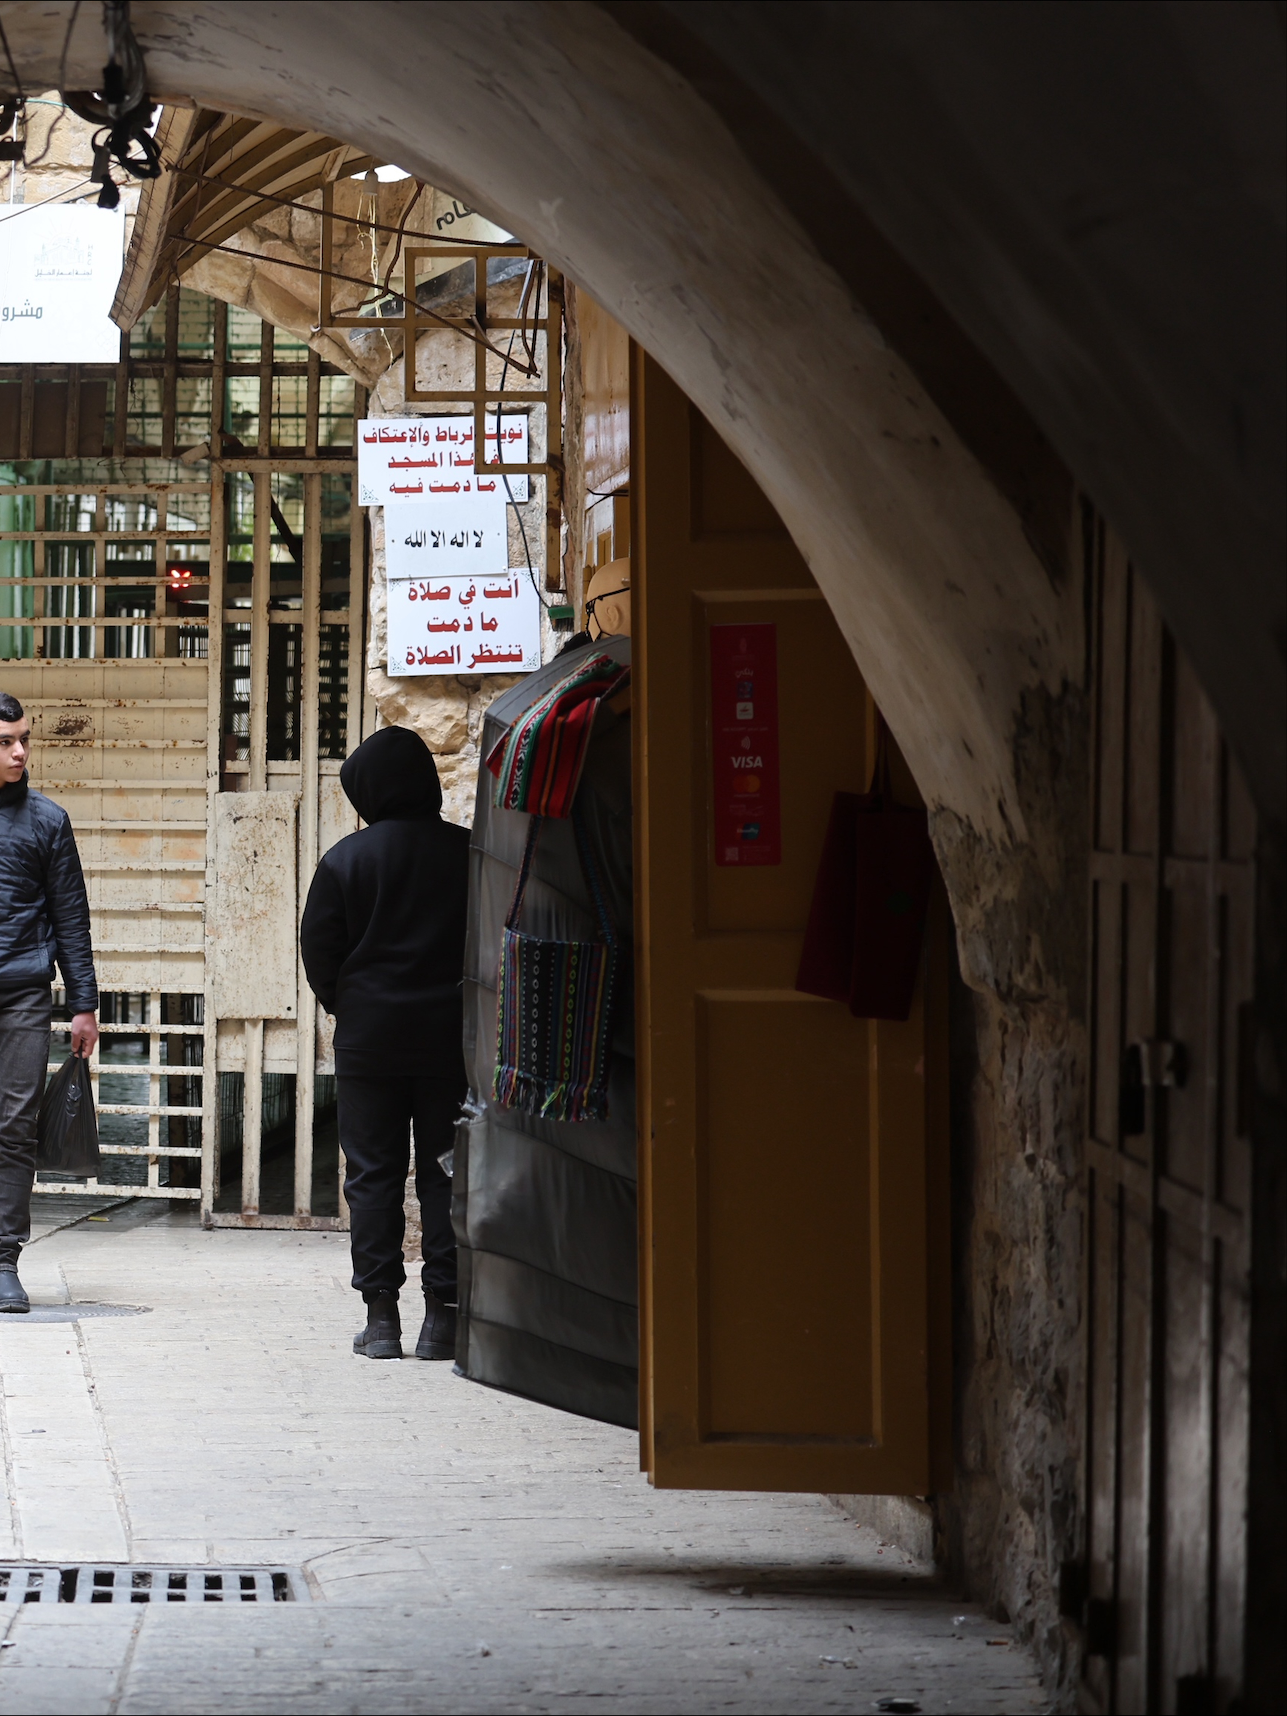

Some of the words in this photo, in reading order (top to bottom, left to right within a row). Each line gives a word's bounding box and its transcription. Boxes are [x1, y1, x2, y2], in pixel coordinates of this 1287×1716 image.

[435, 424, 474, 446] لرباط
[388, 451, 443, 472] المسجد
[389, 477, 424, 498] فيه
[428, 479, 471, 494] دمت
[477, 476, 497, 492] ما
[404, 529, 427, 548] الله
[430, 529, 446, 548] الا
[449, 529, 469, 548] اله
[473, 529, 484, 548] لا
[408, 580, 452, 602] صلاة
[458, 578, 477, 610] في
[483, 572, 519, 599] أنت
[426, 615, 473, 634] دمت
[480, 611, 499, 633] ما
[405, 643, 461, 666] الصلاة
[466, 643, 524, 670] تنتظر
[730, 755, 764, 769] VISA
